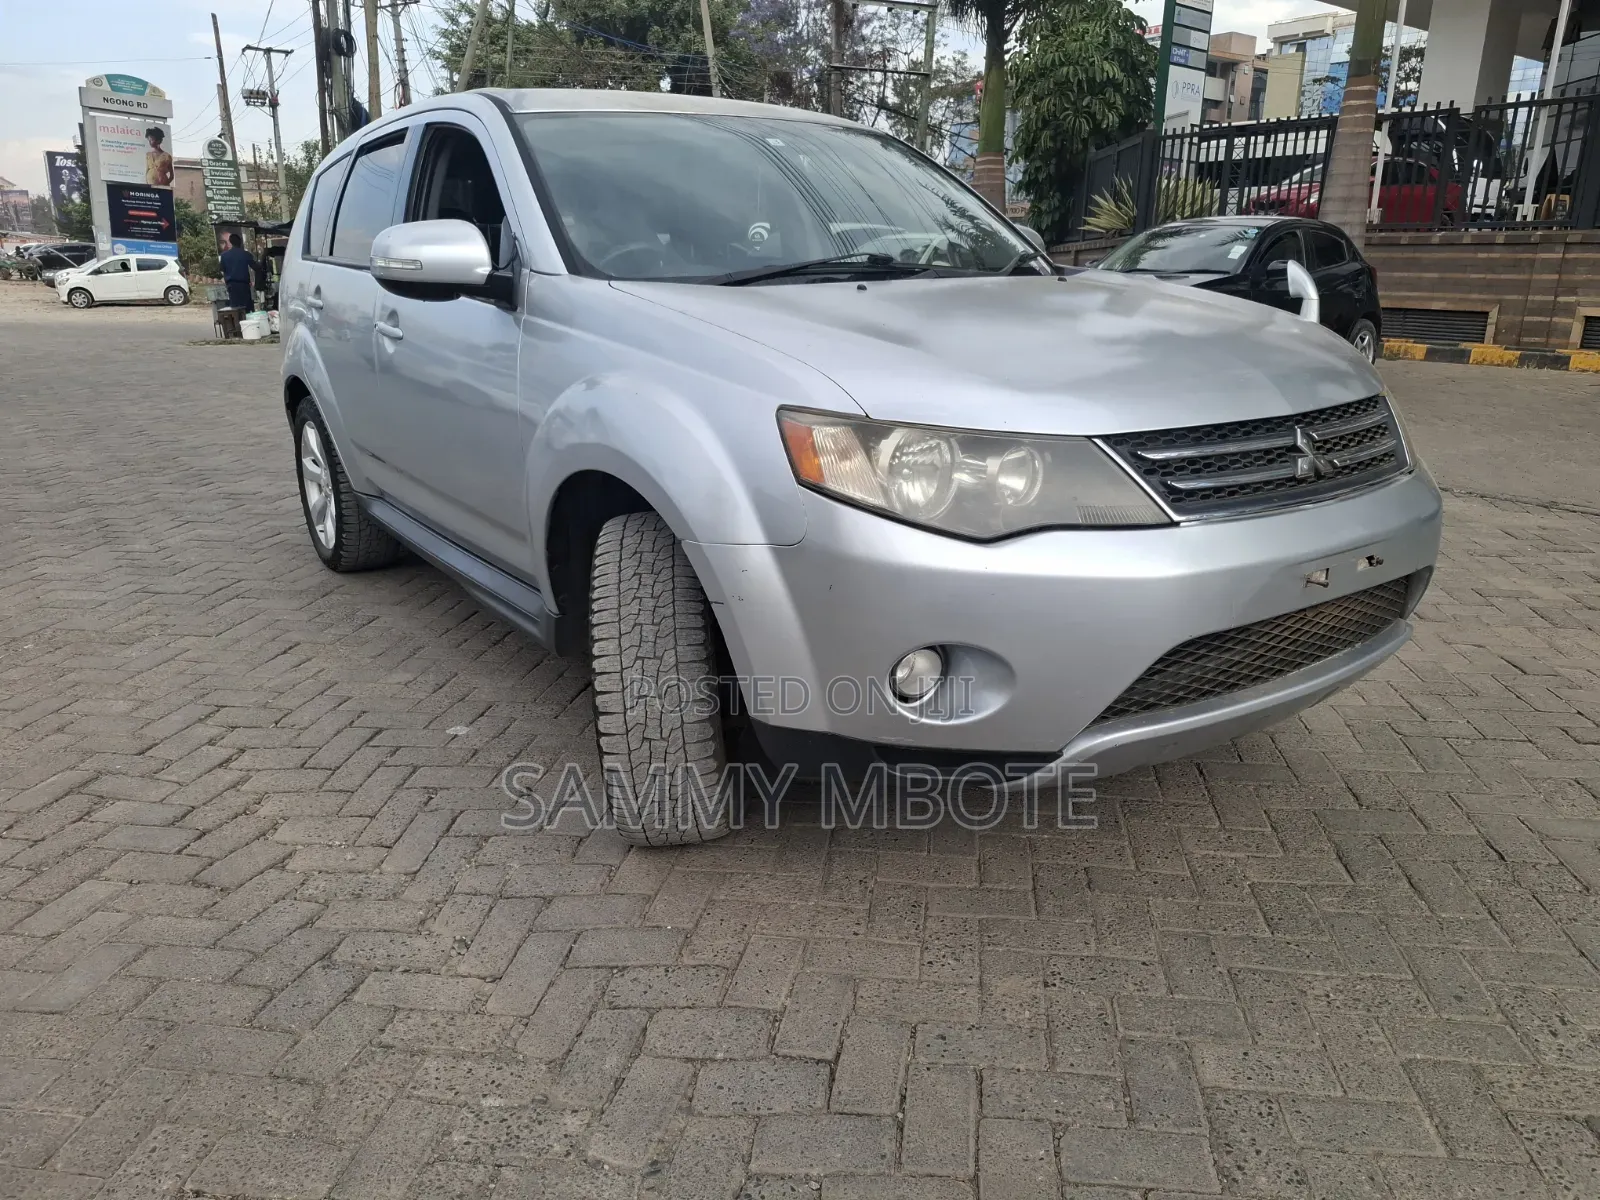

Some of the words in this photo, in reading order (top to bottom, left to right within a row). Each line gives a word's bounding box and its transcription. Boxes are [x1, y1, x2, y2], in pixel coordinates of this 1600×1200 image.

[1182, 81, 1200, 96] PPRA
[103, 97, 134, 107] NGONG
[136, 101, 148, 109] RD
[99, 125, 142, 137] malaica
[129, 191, 160, 199] MORINGA
[213, 194, 242, 202] Whitening
